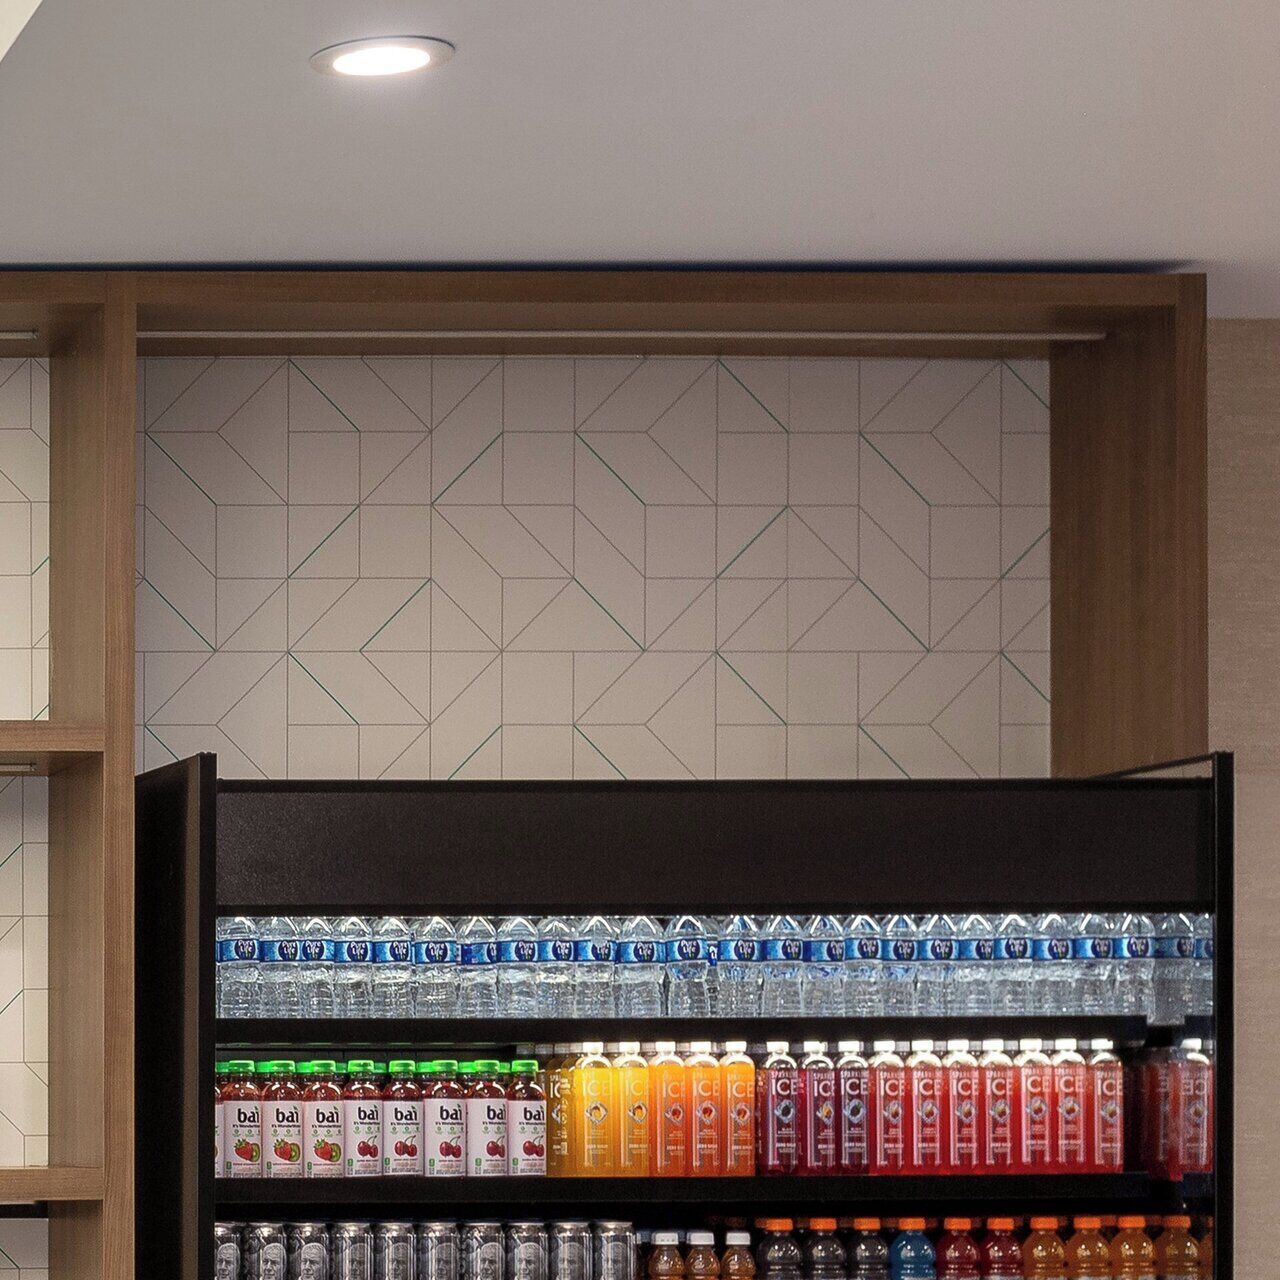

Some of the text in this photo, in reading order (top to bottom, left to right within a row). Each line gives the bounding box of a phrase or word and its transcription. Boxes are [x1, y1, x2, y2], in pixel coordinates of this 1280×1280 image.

[693, 1080, 720, 1097] ICE
[727, 1081, 755, 1098] ICE
[772, 1079, 798, 1096] ICE
[841, 1079, 869, 1096] ICE
[914, 1079, 942, 1096] ICE
[1023, 1076, 1051, 1093] ICE
[1056, 1076, 1084, 1093] ICE
[238, 1105, 259, 1123] bai
[276, 1105, 299, 1123] bai
[316, 1105, 339, 1123] bai
[358, 1105, 379, 1121] bai
[394, 1105, 417, 1121] bai
[440, 1104, 462, 1121] bai
[487, 1104, 506, 1120] bai
[524, 1105, 545, 1121] bai
